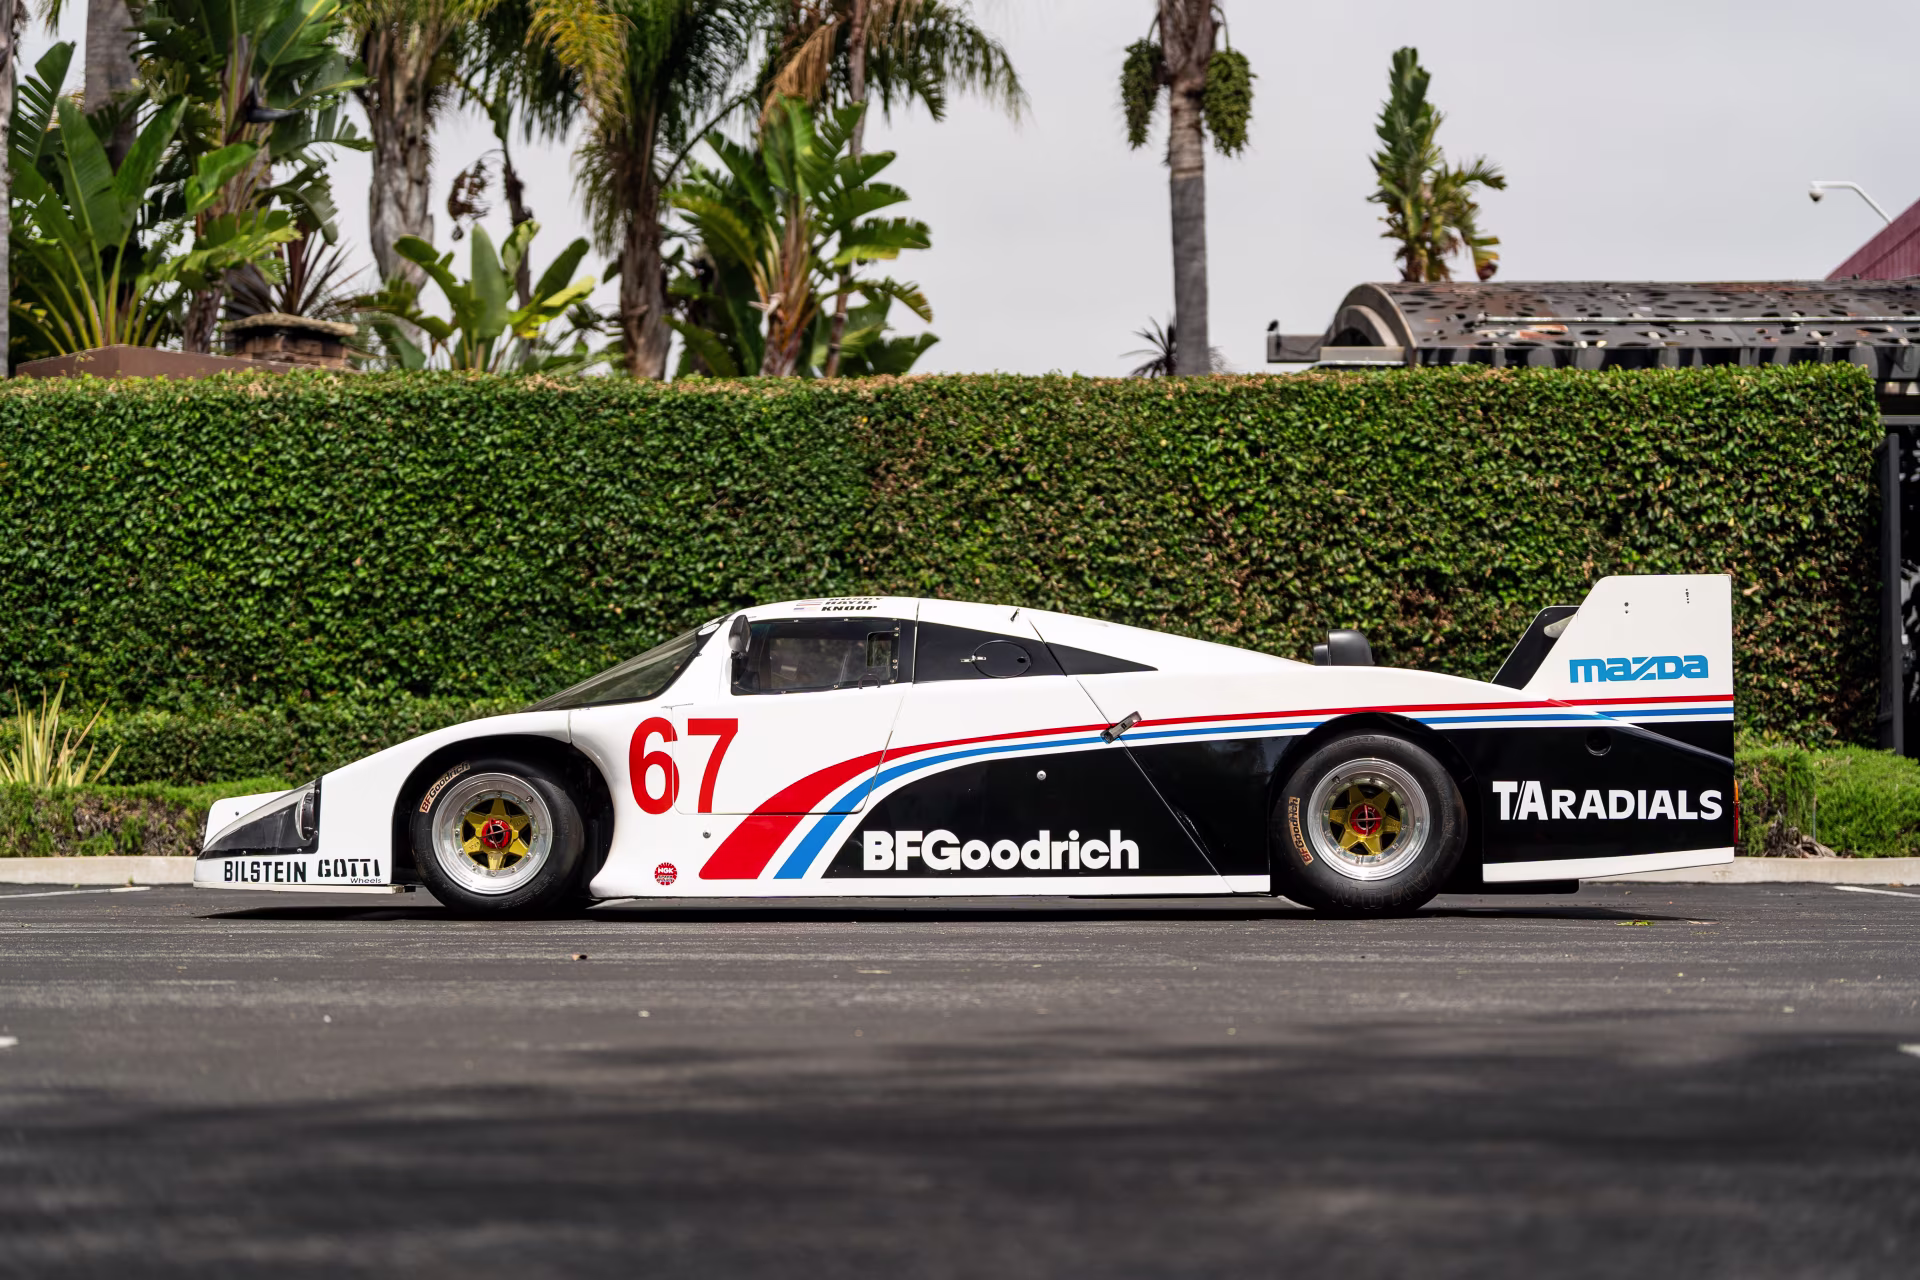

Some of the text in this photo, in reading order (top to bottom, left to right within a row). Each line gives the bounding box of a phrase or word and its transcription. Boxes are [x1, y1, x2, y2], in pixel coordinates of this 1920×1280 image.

[421, 762, 469, 812] BFGoodrich
[629, 716, 738, 815] 67
[1551, 789, 1723, 821] RADIALS
[863, 829, 1140, 871] BFGoodrich
[1289, 798, 1313, 864] BFGoodrich
[224, 858, 381, 883] BILSTEIN GOTTI
